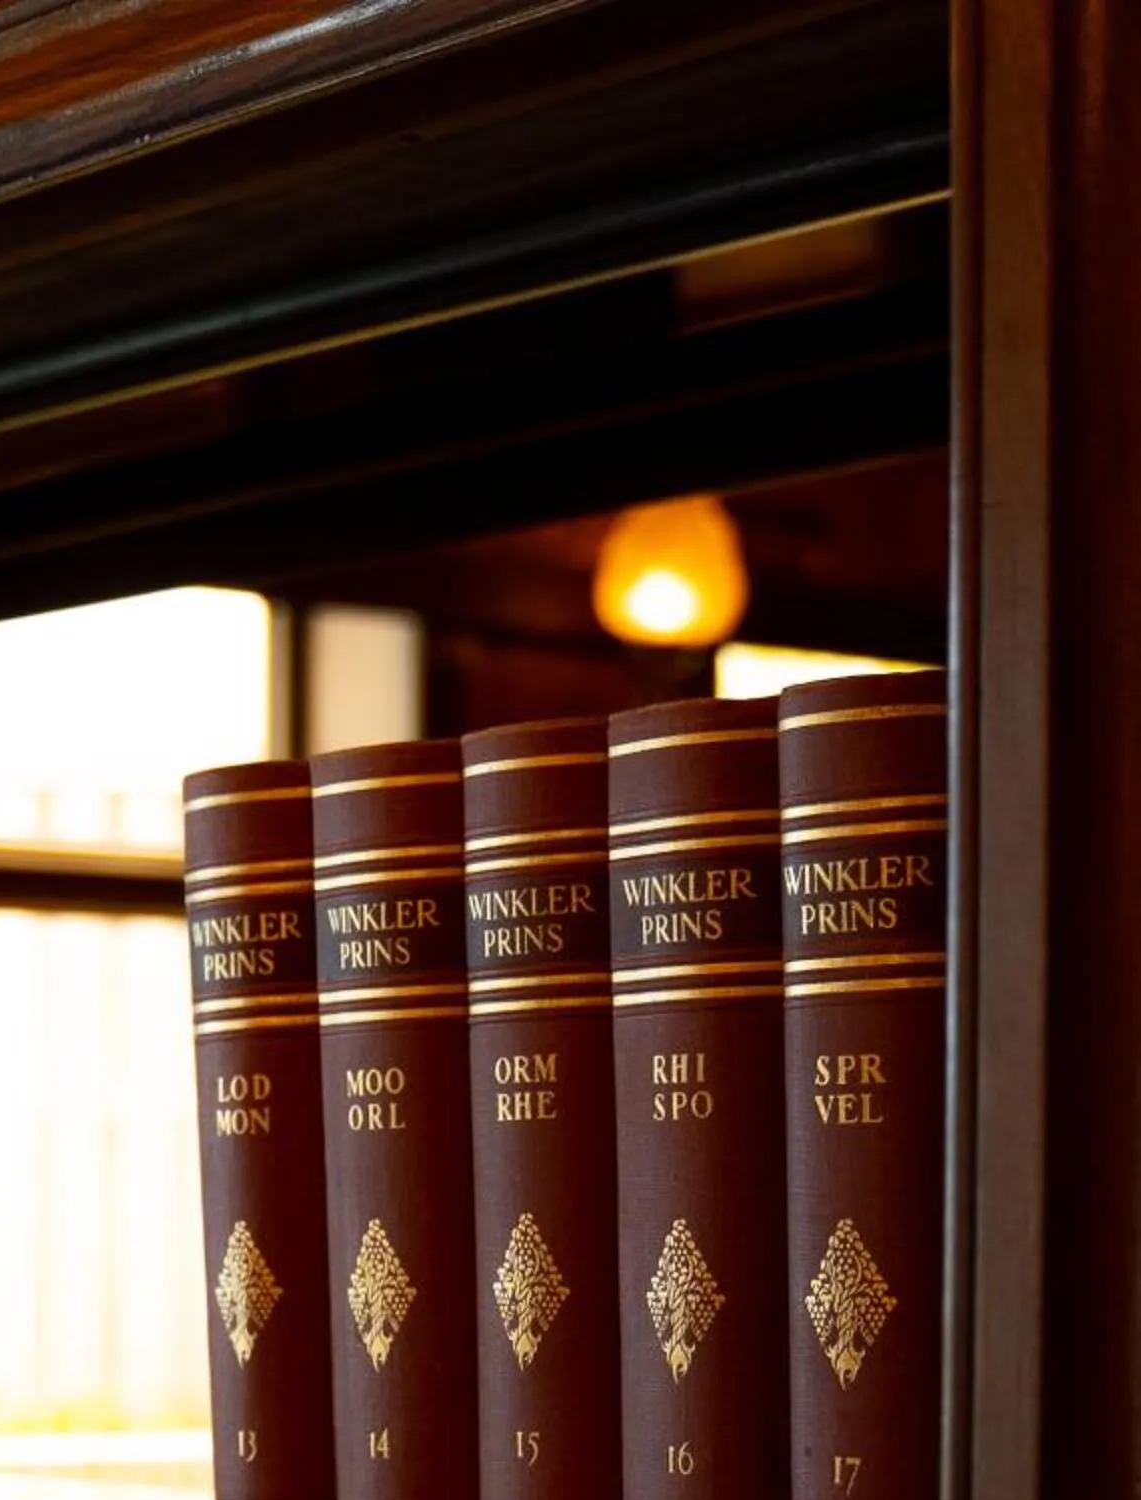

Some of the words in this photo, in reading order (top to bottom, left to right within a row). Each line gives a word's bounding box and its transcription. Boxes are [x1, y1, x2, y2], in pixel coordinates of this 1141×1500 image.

[622, 868, 757, 907] WINKLER
[783, 855, 934, 897] WINKLER
[327, 899, 441, 934] WINKLER
[468, 884, 595, 921] WINKLER
[801, 898, 898, 935] PRINS
[192, 911, 302, 947] WINKLER
[484, 924, 564, 957] PRINS
[642, 910, 723, 945] PRINS
[203, 948, 275, 982] PRINS
[340, 937, 411, 970] PRINS
[346, 1067, 405, 1098] MOO
[495, 1053, 558, 1084] ORM
[652, 1054, 706, 1084] RHI
[814, 1054, 887, 1086] SPR
[217, 1073, 271, 1103] LOD
[216, 1108, 271, 1136] MON
[348, 1103, 407, 1131] ORL
[497, 1090, 557, 1122] RHE
[652, 1091, 713, 1121] SPO
[815, 1093, 884, 1125] VEL
[238, 1430, 258, 1463] 13
[369, 1428, 391, 1459] 14
[516, 1431, 540, 1468] 15
[668, 1441, 694, 1475] 16
[833, 1456, 862, 1496] 17
